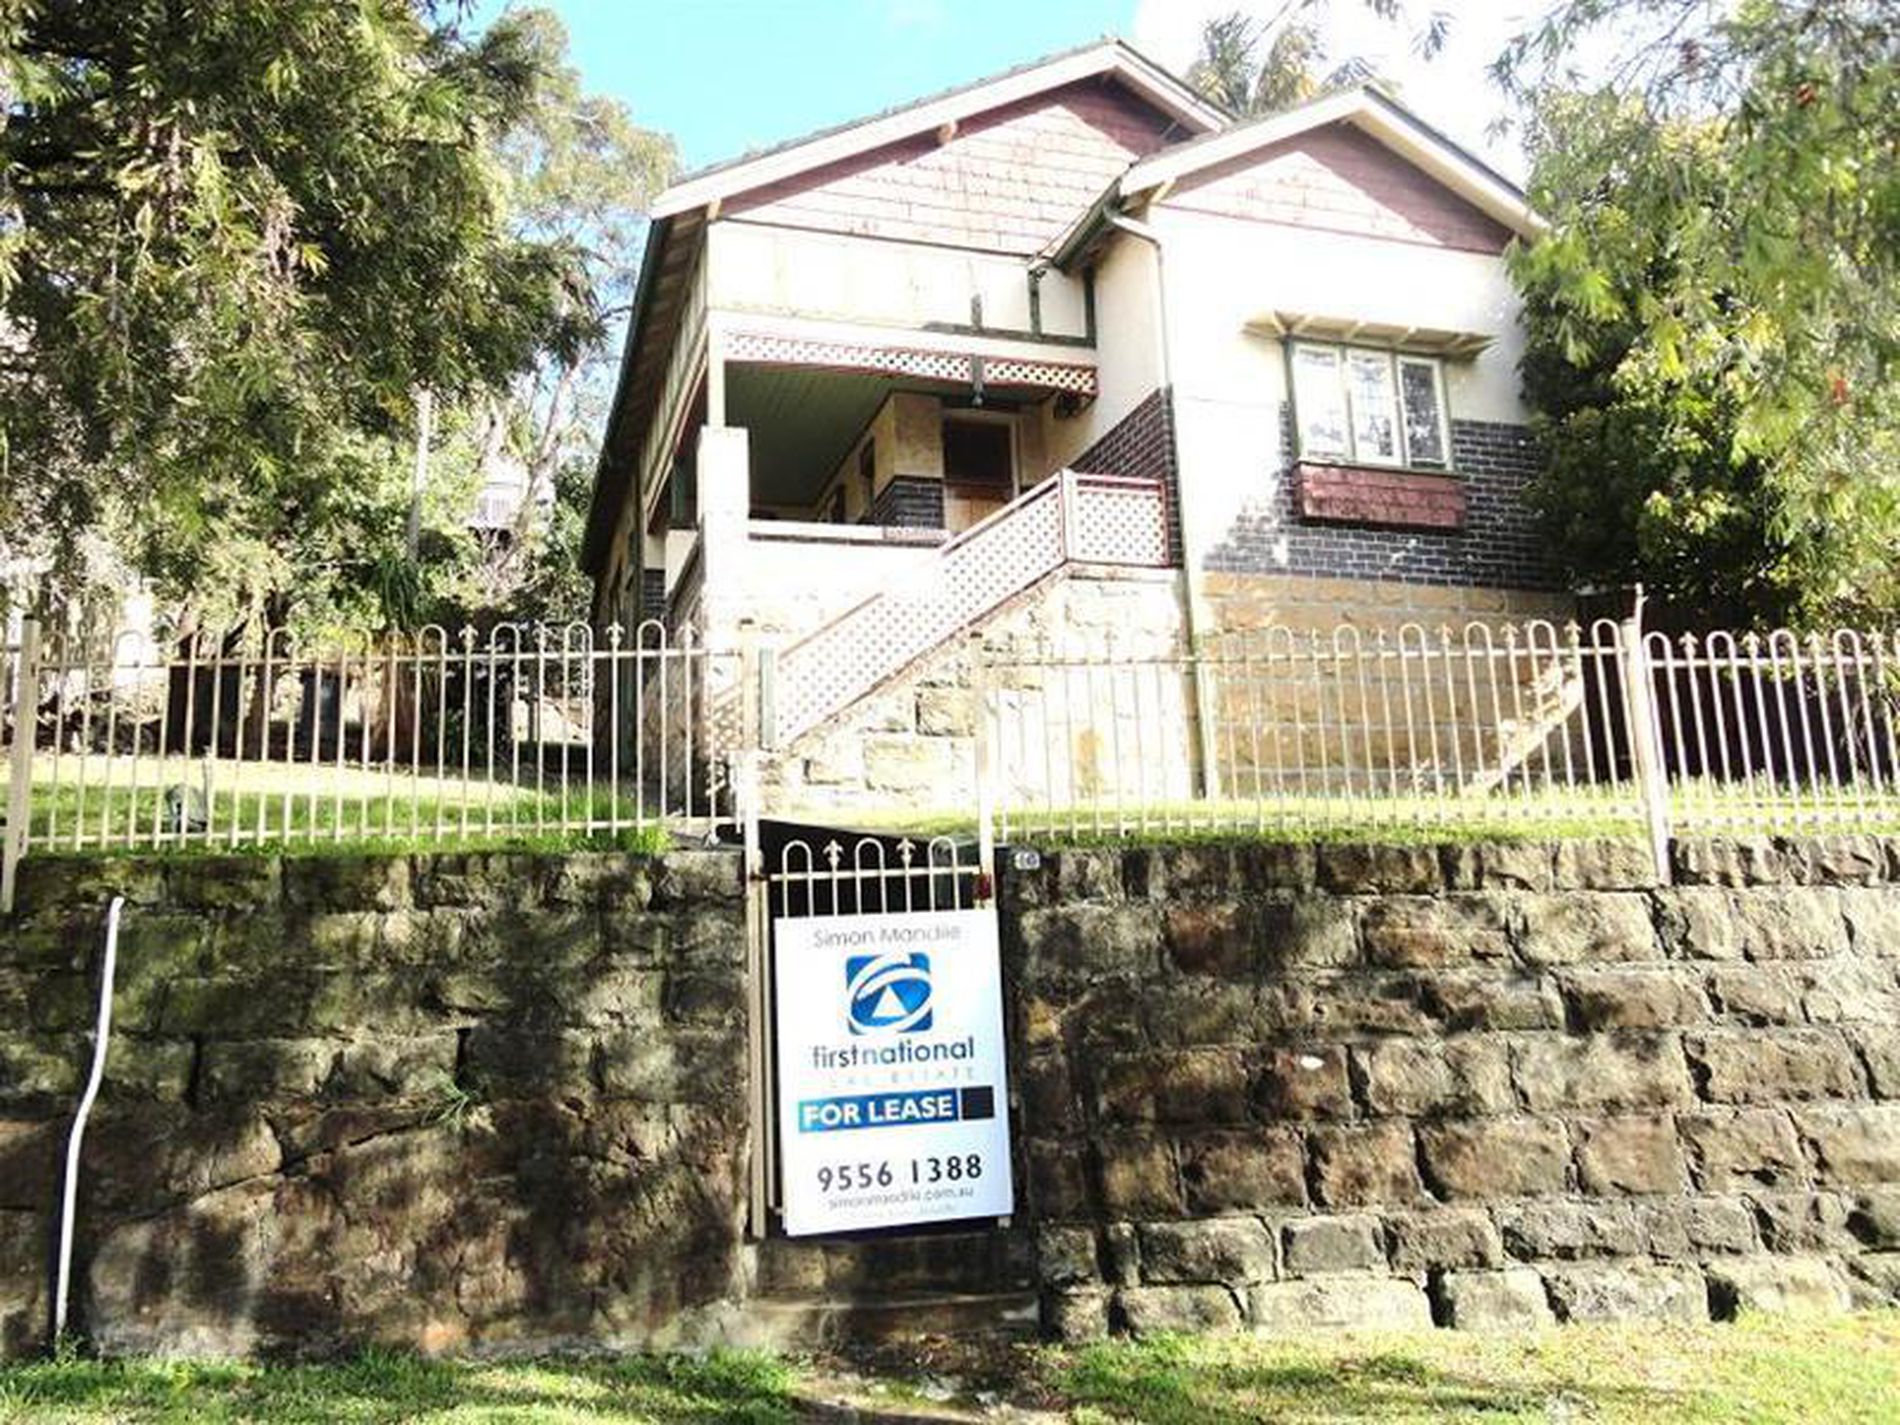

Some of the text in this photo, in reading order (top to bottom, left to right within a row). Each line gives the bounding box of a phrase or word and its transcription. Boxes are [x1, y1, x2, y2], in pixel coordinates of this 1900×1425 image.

[813, 928, 876, 948] Simon
[811, 1036, 976, 1069] firstnational
[803, 1094, 953, 1128] FOR LEASE
[817, 1154, 983, 1192] 9556 1388
